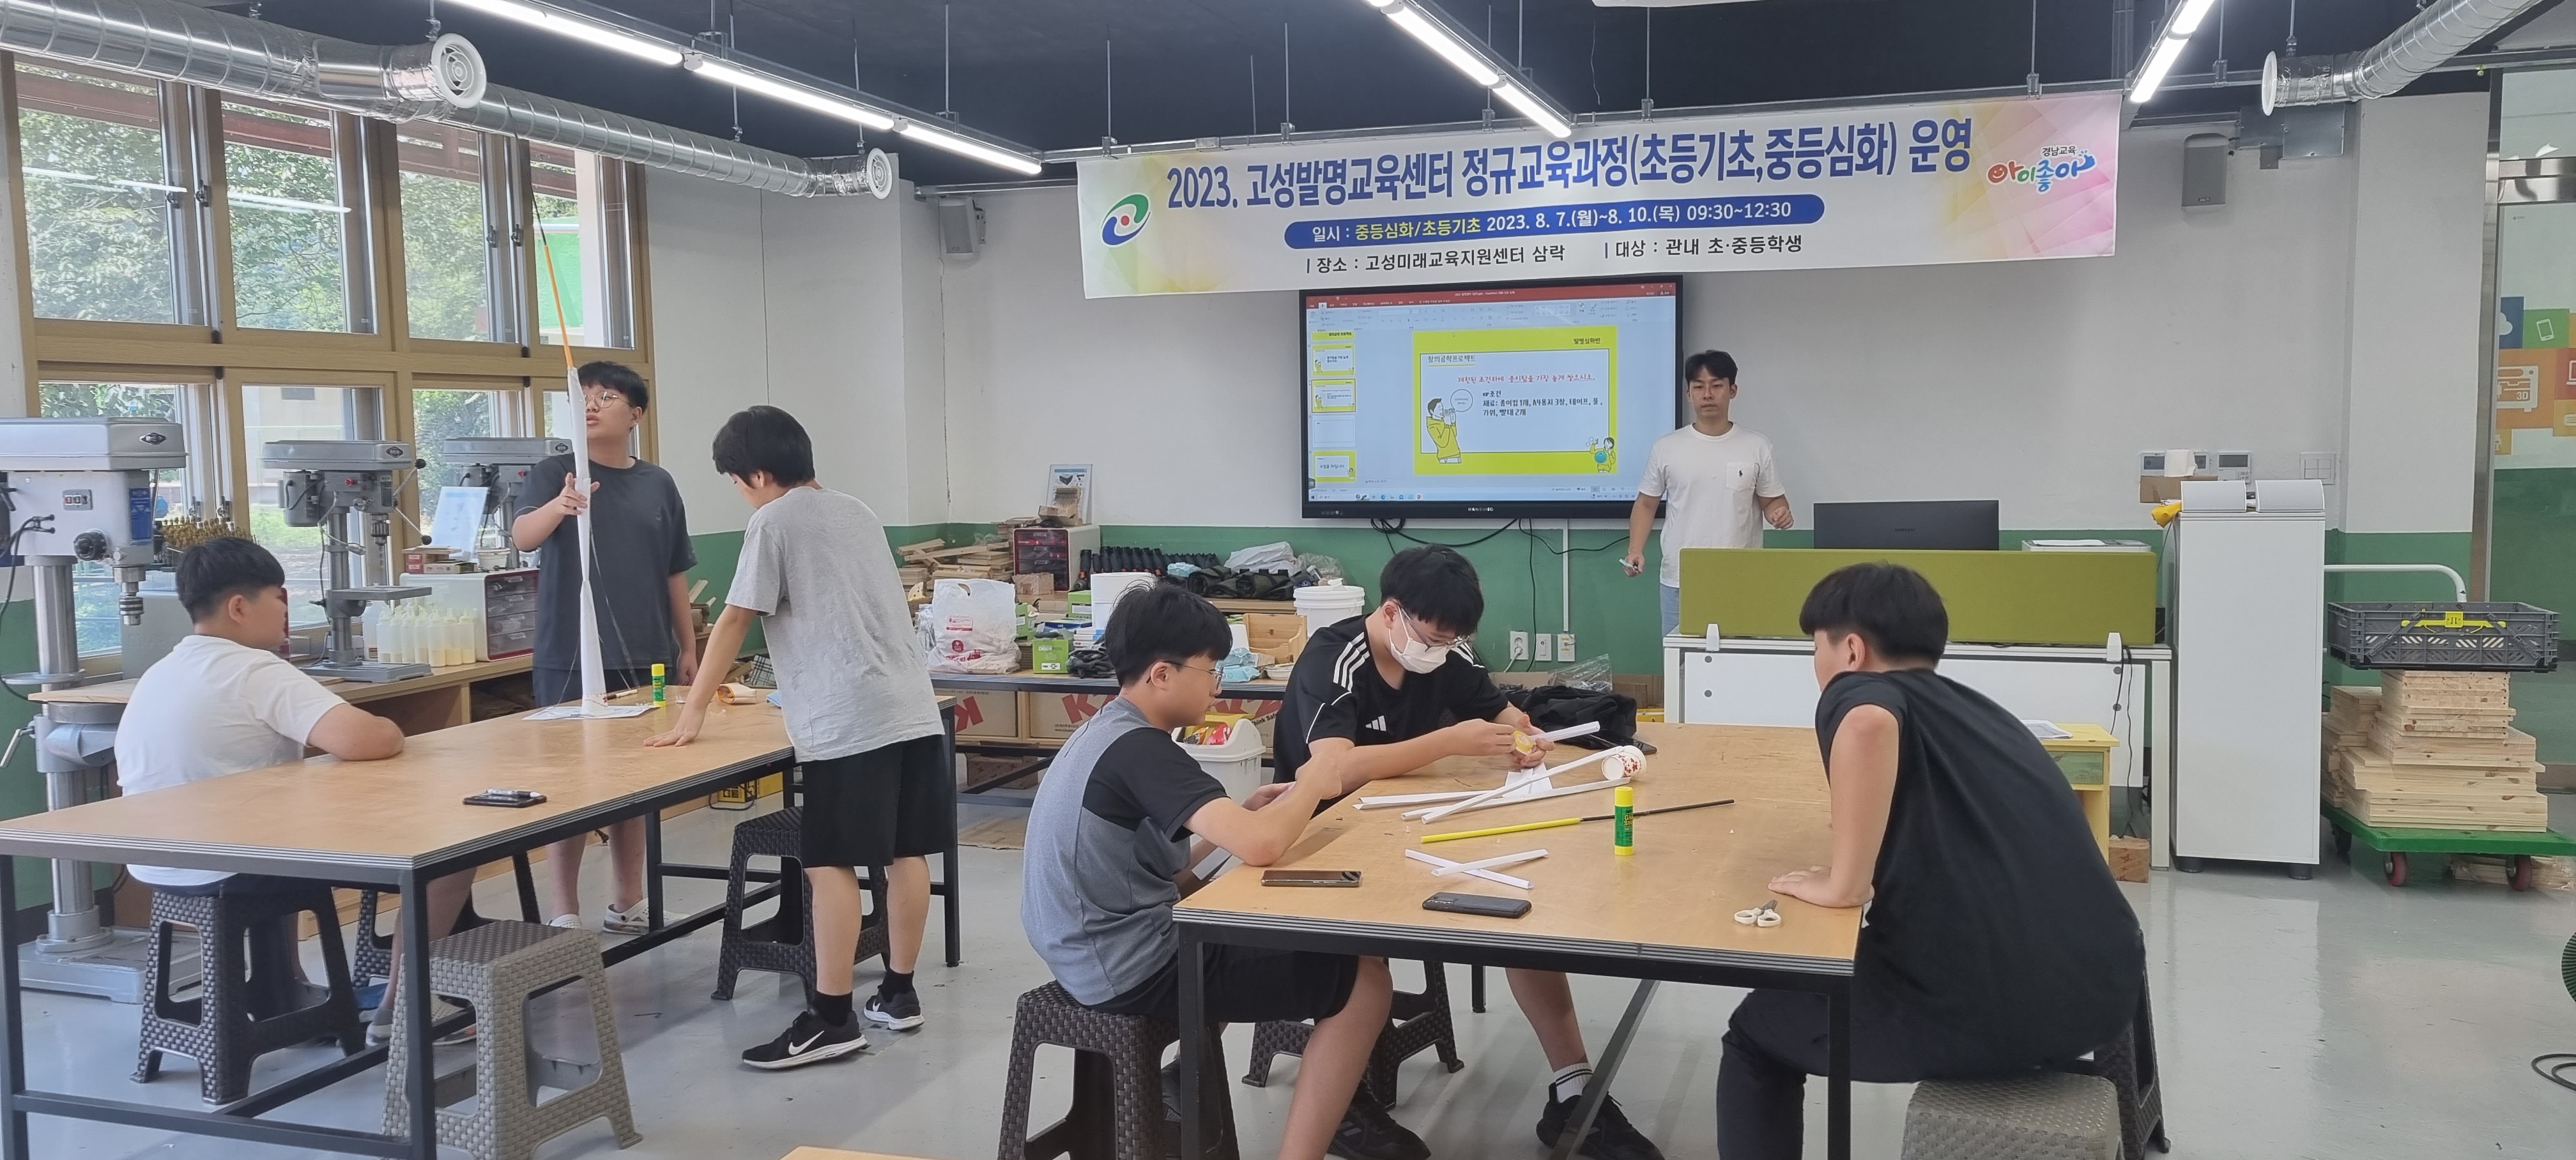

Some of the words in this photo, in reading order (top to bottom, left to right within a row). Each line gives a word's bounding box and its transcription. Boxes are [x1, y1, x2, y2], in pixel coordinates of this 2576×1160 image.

[1167, 166, 1238, 208] 2023.
[1246, 151, 1453, 208] 고성발명교육센터
[1462, 121, 1897, 197] 정규교육과정(초등기초,중등심화)
[1909, 118, 1972, 173] 운영
[2042, 146, 2076, 156] 경남교육
[1988, 155, 2096, 192] 아이좋아
[1312, 225, 1340, 242] 일시
[1355, 217, 1482, 241] 중등심화/초등기초
[1487, 215, 1530, 231] 2023.
[1535, 213, 1550, 228] 8.
[1628, 205, 1680, 224] 10.(목)
[1687, 202, 1791, 221] 09:30~12:30
[1616, 240, 1646, 258] 대상
[1666, 238, 1699, 256] 관내
[1708, 234, 1802, 255] 초·중등학생
[1316, 257, 1347, 273] 장소
[1365, 247, 1525, 271] 고성미래교육지원센터
[1533, 245, 1565, 264] 삼락
[1427, 355, 1476, 363] 창의공학프로젝트
[2517, 392, 2529, 401] 3D
[1252, 718, 1266, 726] hink
